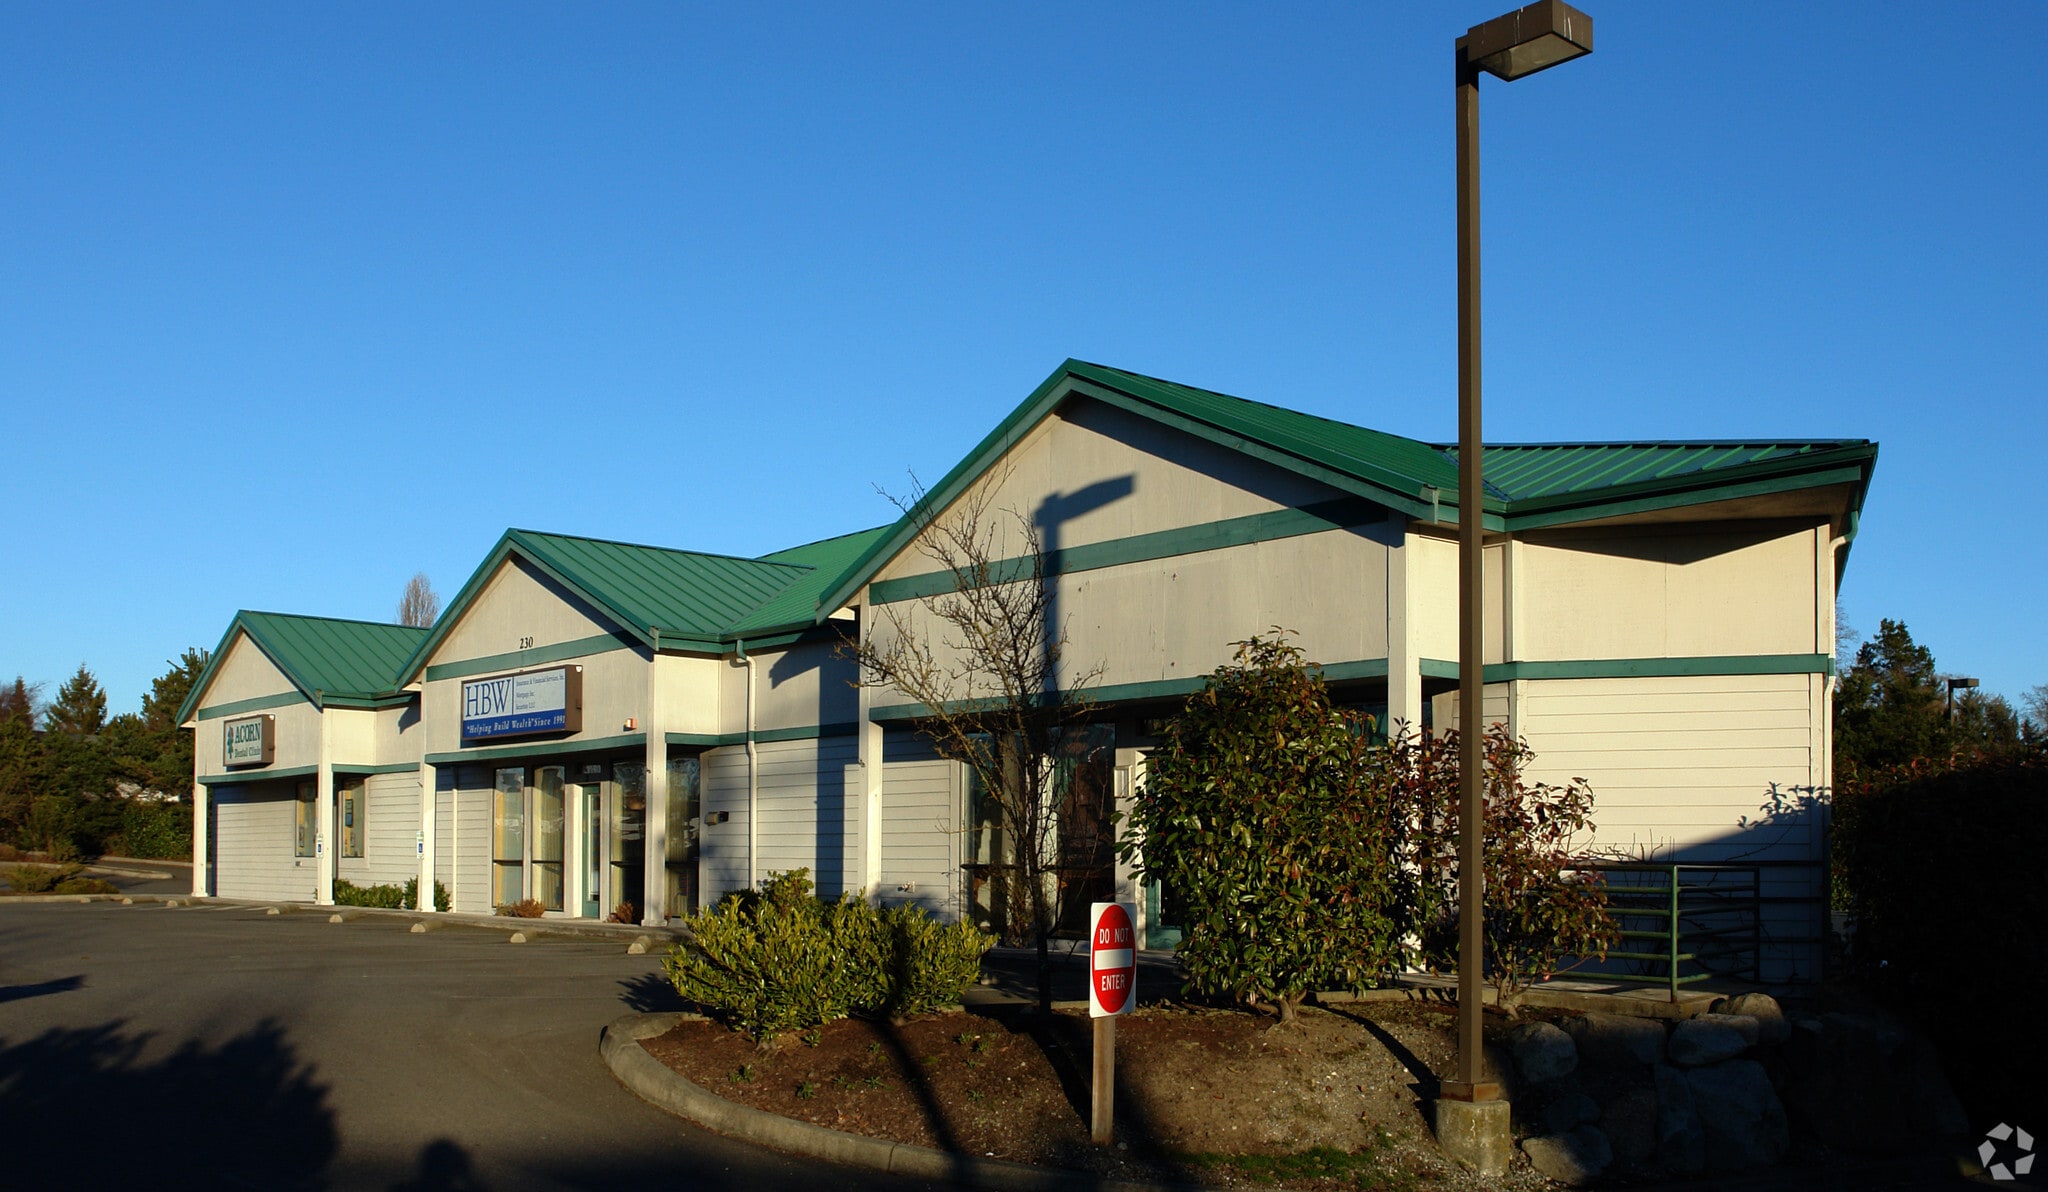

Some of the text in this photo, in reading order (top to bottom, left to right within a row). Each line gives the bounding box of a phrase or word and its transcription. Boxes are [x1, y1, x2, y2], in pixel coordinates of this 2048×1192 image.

[520, 636, 534, 649] 230
[466, 680, 511, 717] HBW
[234, 722, 261, 743] ACORN
[494, 721, 509, 731] Build
[1099, 928, 1129, 944] DO NOT
[1101, 974, 1125, 991] ENTER
